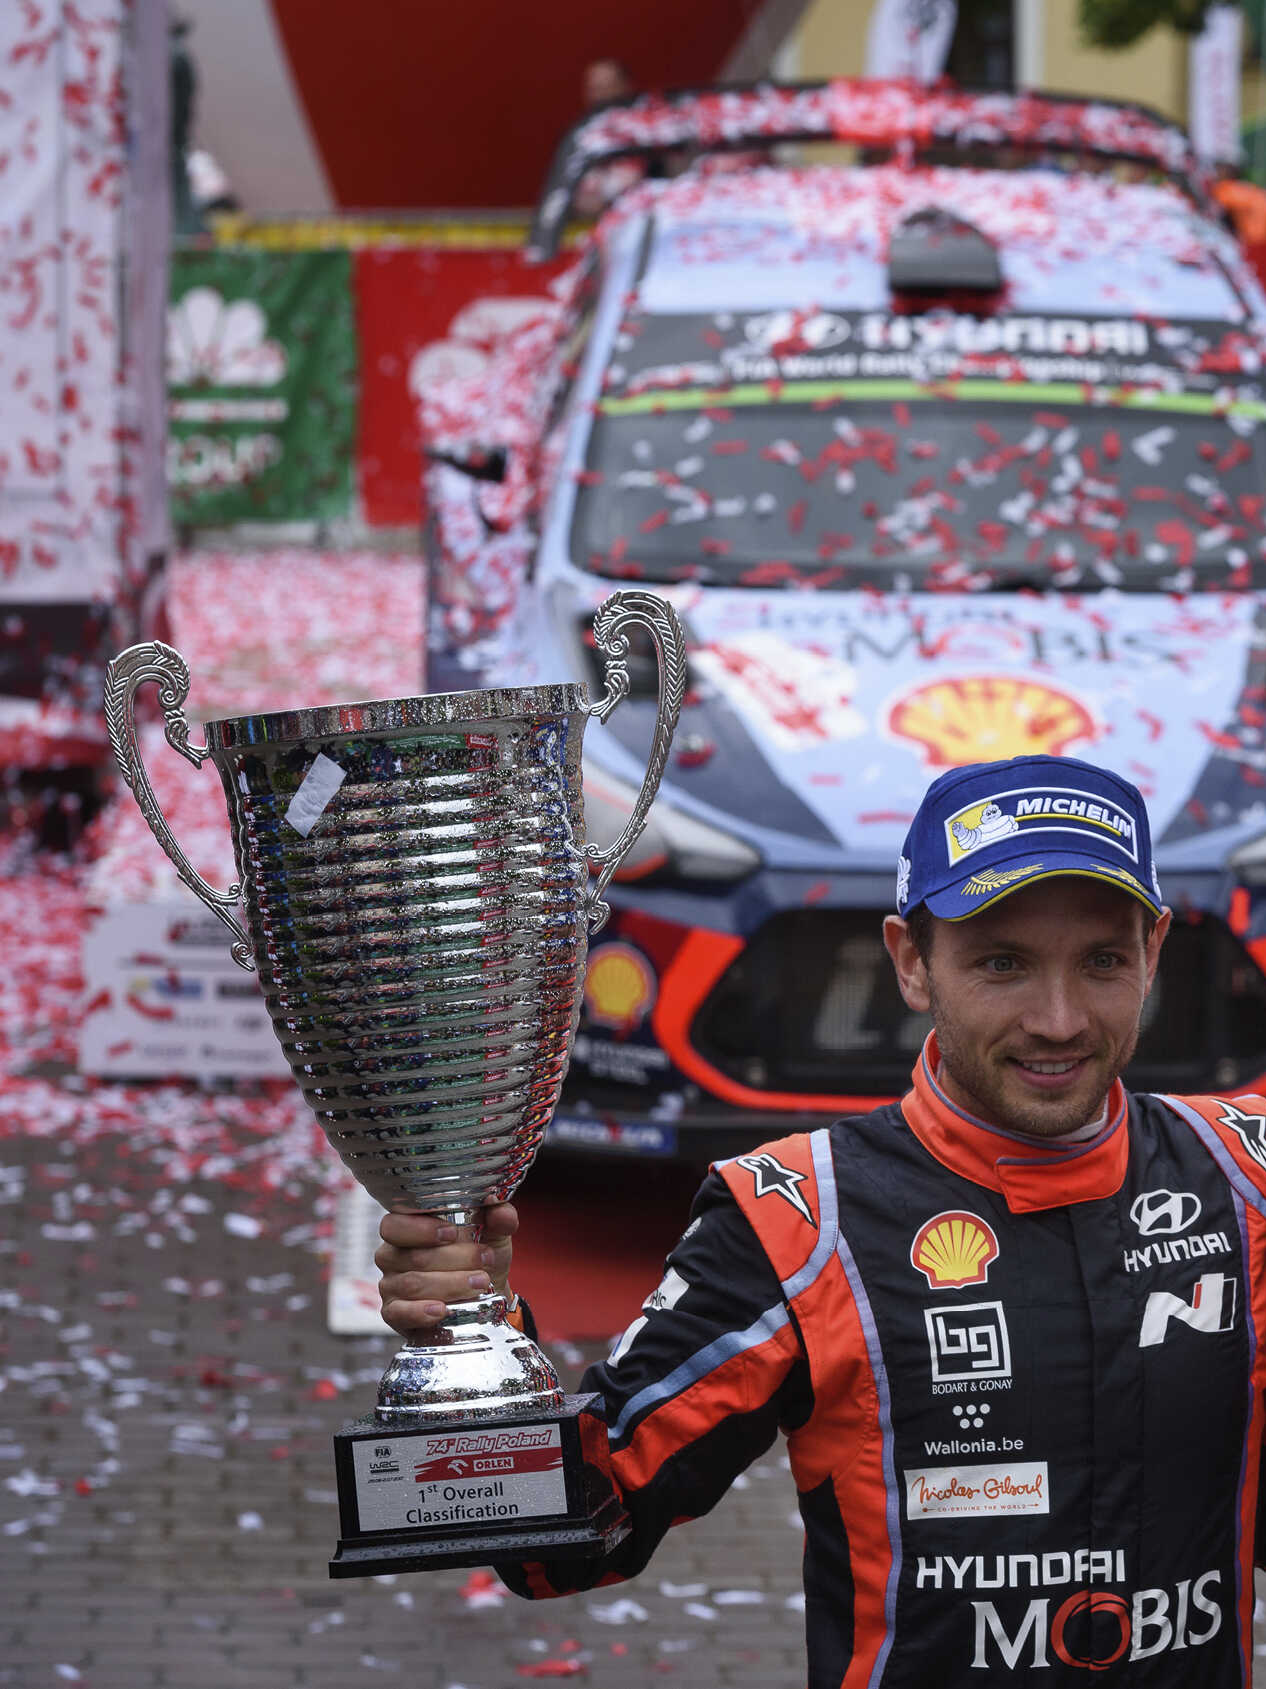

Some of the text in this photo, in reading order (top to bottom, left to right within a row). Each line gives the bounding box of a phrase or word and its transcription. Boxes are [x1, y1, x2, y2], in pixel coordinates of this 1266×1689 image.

[1016, 797, 1133, 839] MICHELIN
[1123, 1232, 1232, 1272] HYUNDAI
[932, 1379, 1013, 1395] BODART & GONAY
[455, 1435, 498, 1454] Rally
[496, 1430, 552, 1450] Poland
[924, 1437, 1024, 1456] Wallonia.be
[475, 1457, 513, 1470] ORLEN
[418, 1481, 504, 1504] 1st Overall
[911, 1476, 980, 1504] Nicolas
[406, 1502, 519, 1524] Classification
[916, 1549, 1126, 1588] HYUNDAI
[970, 1570, 1222, 1671] MOBIS
